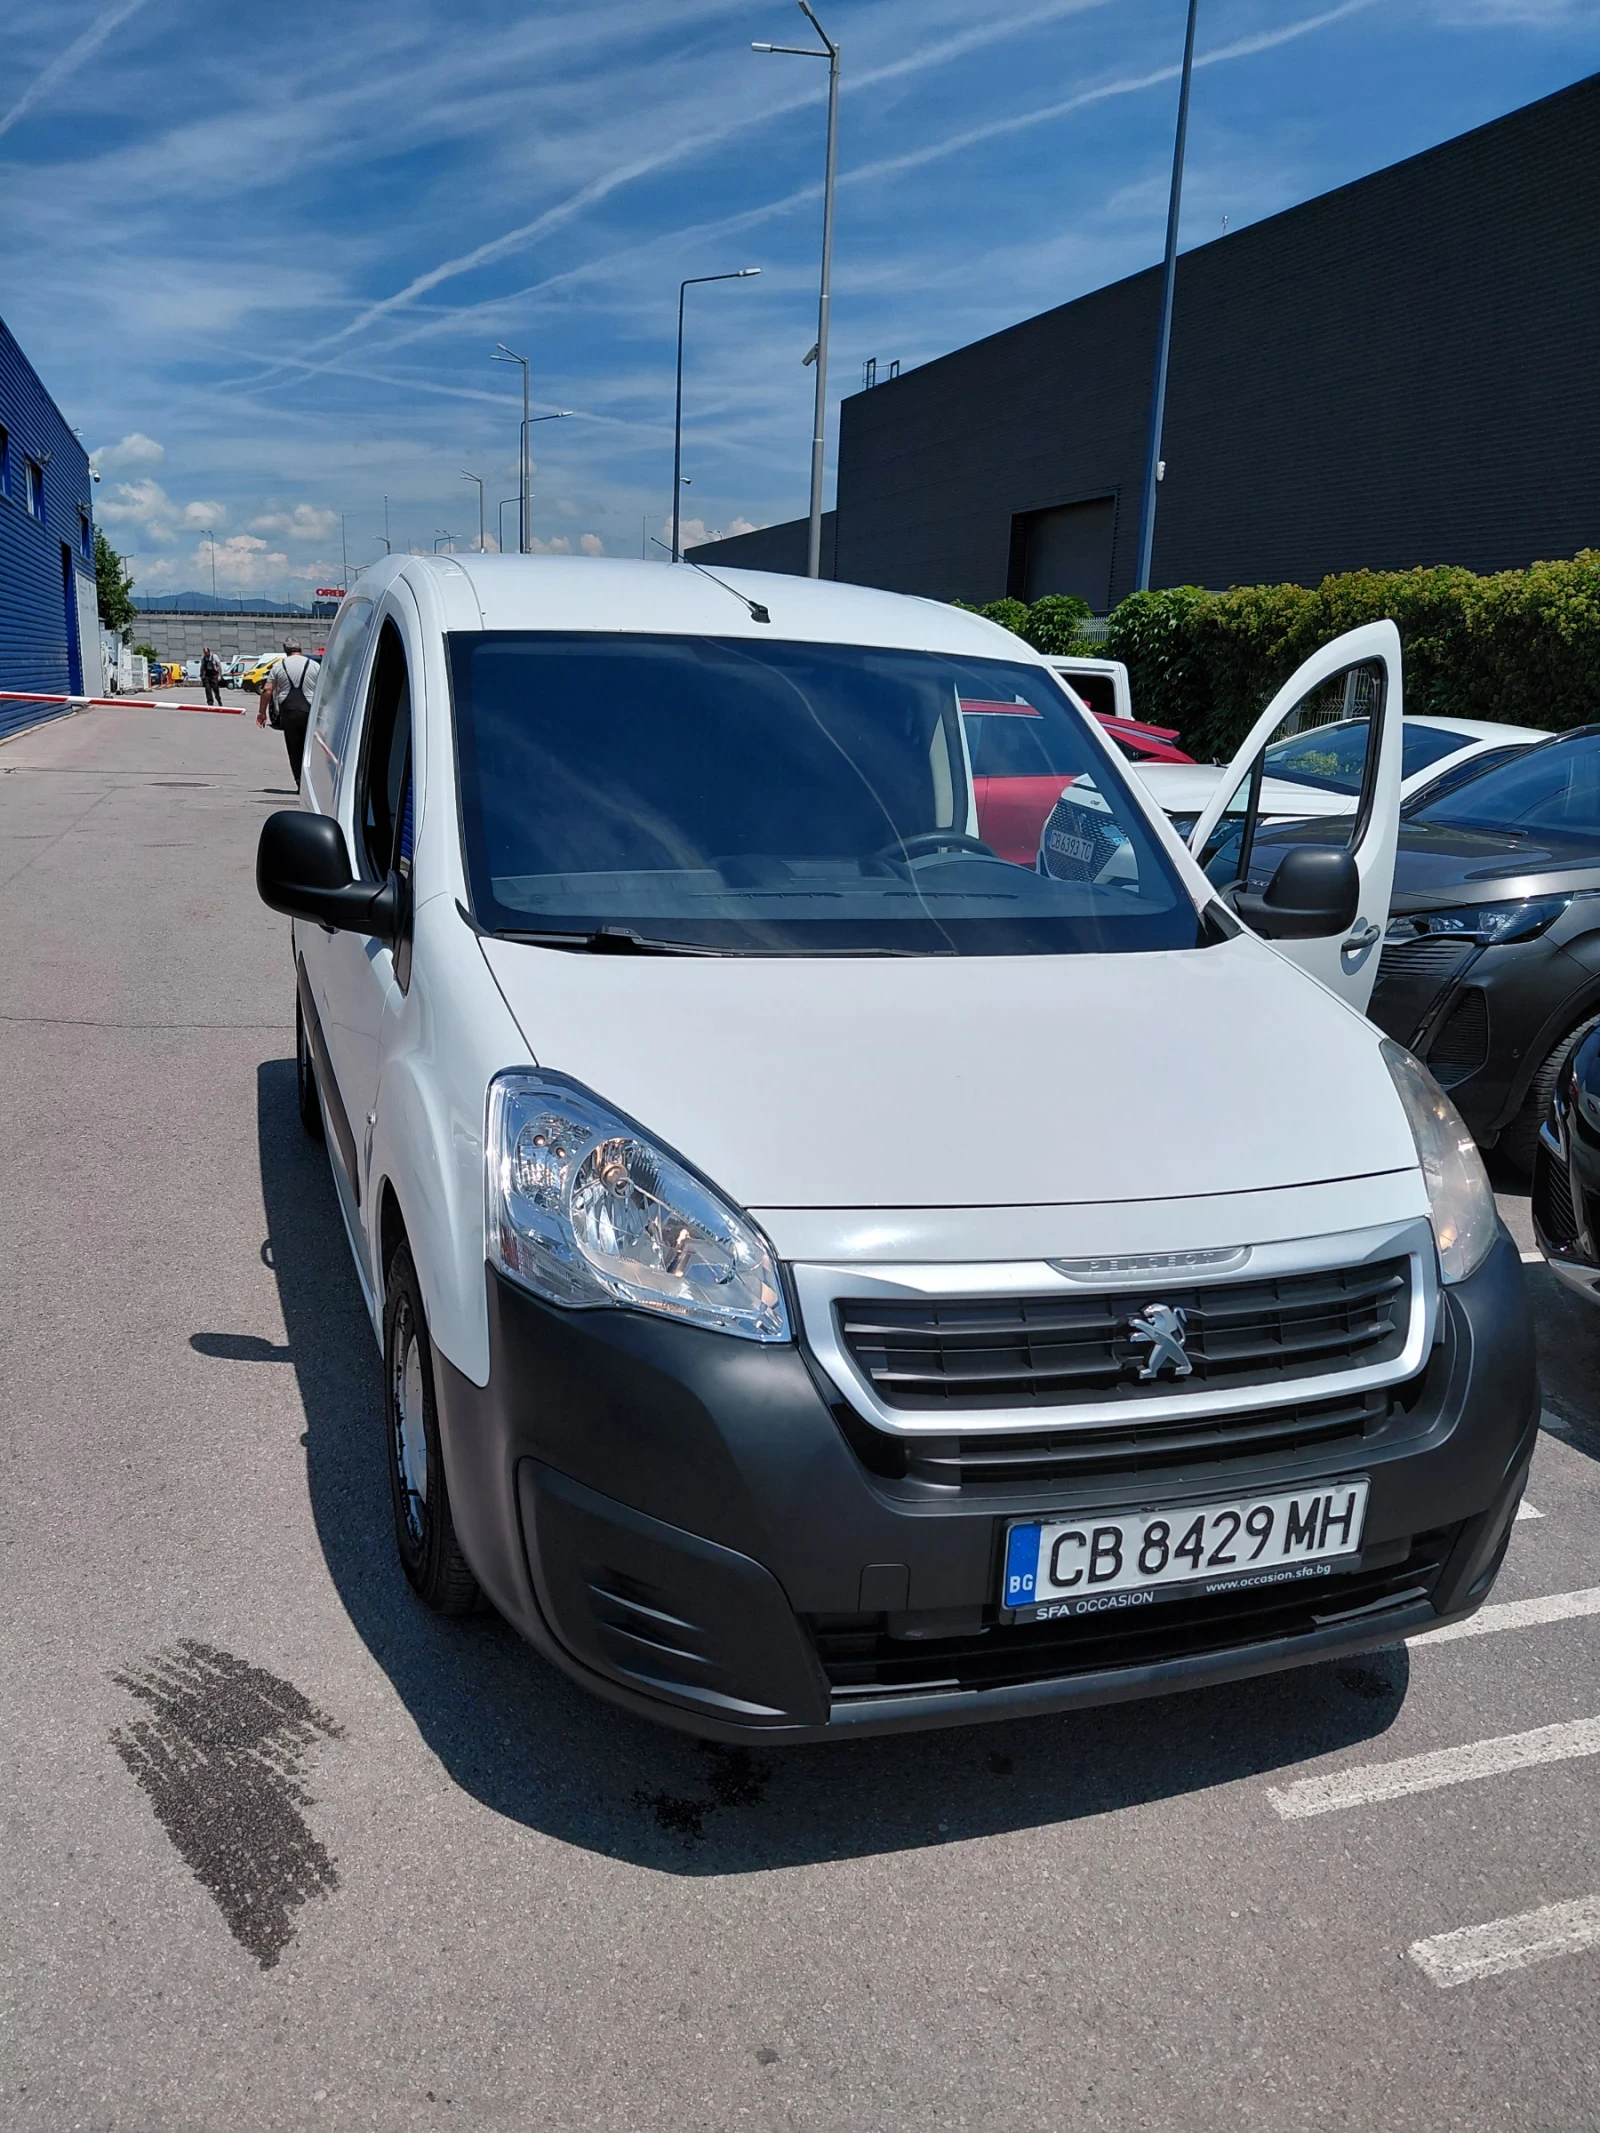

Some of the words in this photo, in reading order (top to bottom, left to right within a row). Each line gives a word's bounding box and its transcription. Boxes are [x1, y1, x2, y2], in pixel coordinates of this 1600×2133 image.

[1049, 1526, 1123, 1587] CB
[1138, 1506, 1274, 1575] 8429
[1283, 1491, 1357, 1554] MH
[1009, 1573, 1034, 1593] BG
[1206, 1564, 1331, 1592] www.occasion.sfa.bg
[1035, 1604, 1070, 1621] SFA
[1076, 1591, 1154, 1614] OCCASION
